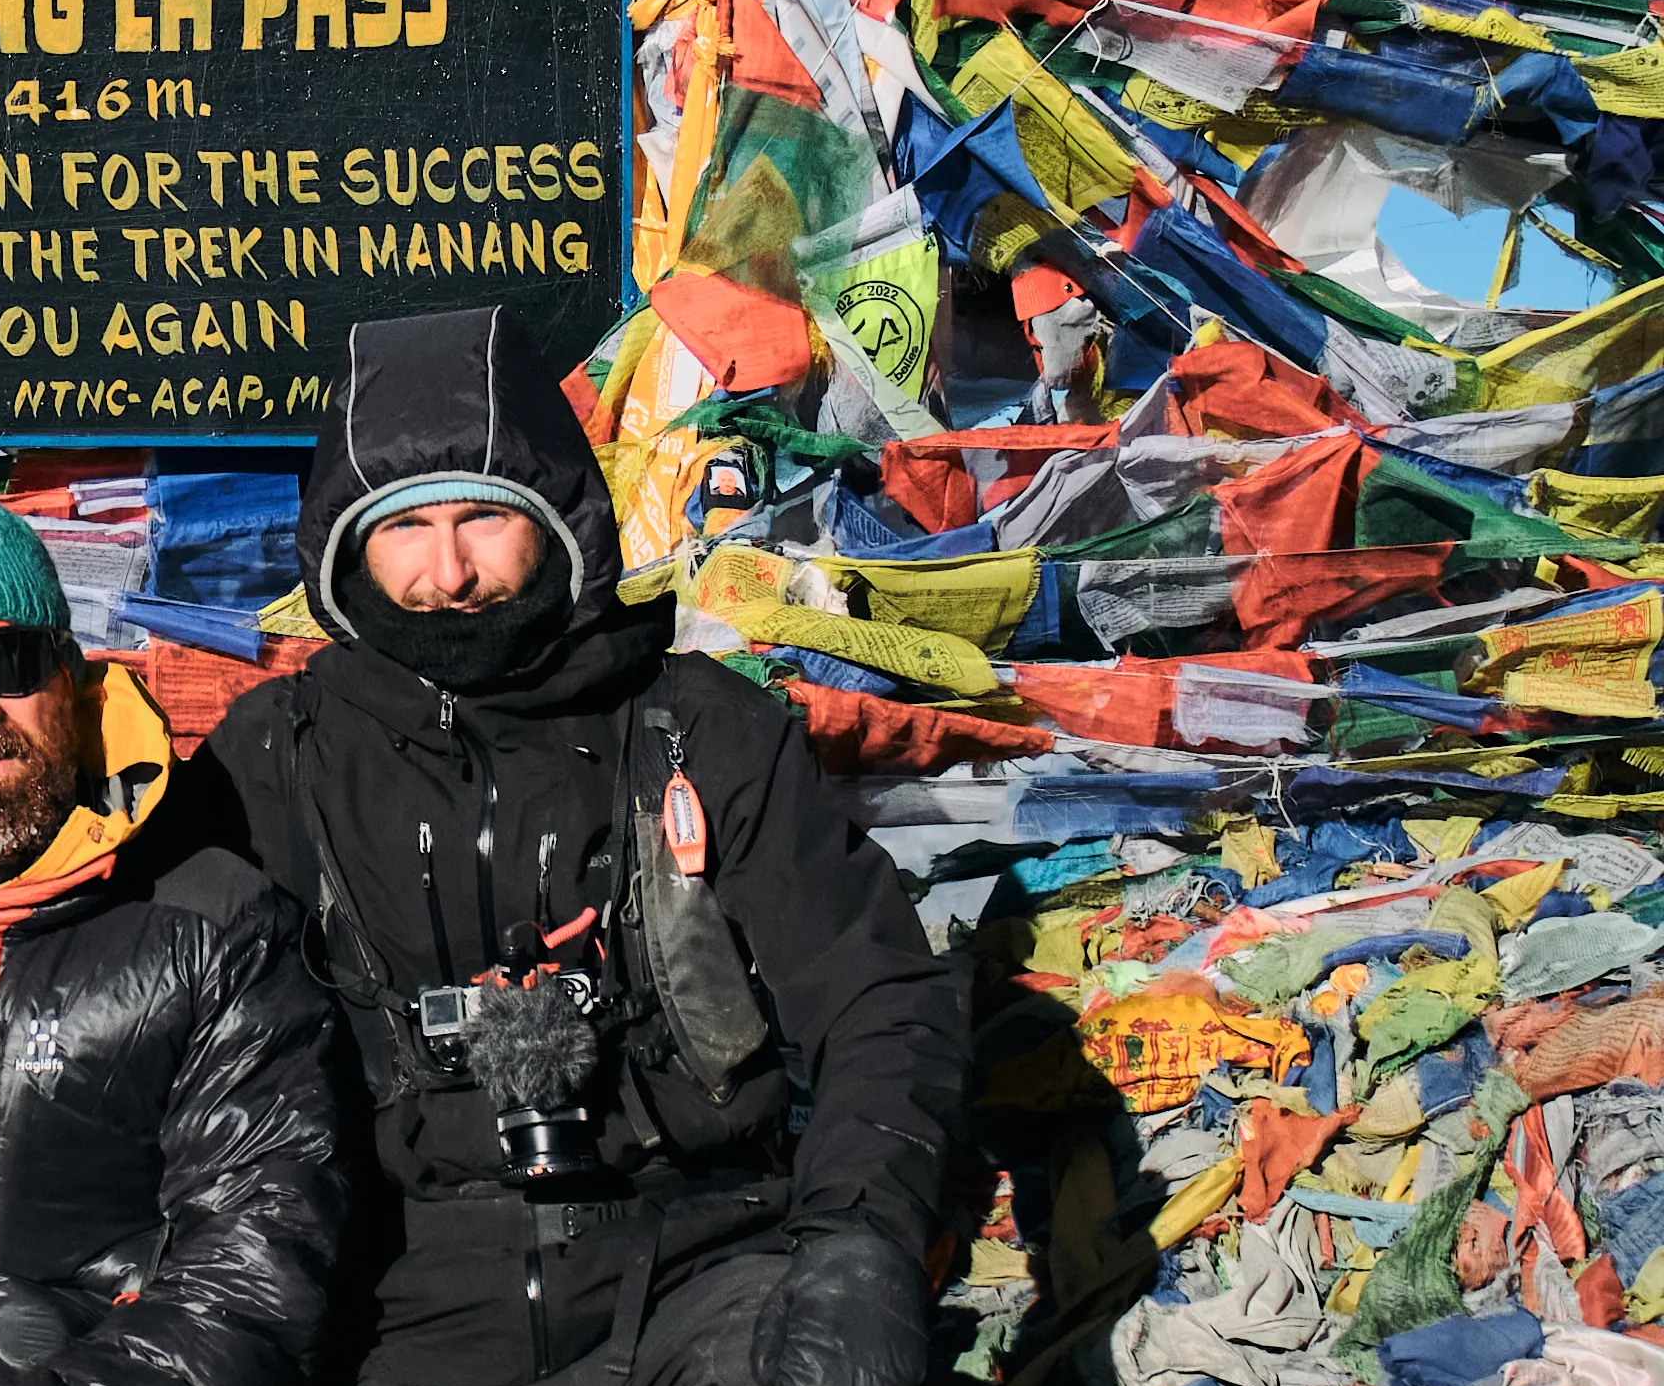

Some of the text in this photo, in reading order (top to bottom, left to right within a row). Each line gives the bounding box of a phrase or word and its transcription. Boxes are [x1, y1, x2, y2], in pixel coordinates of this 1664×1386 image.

[62, 151, 187, 212] FOR
[198, 149, 321, 210] THE
[341, 140, 607, 206] SUCCESS
[121, 225, 268, 285] TREK
[283, 225, 340, 278] IN
[359, 219, 590, 277] MANANG
[867, 285, 899, 301] 2022
[101, 298, 307, 357] AGAIN
